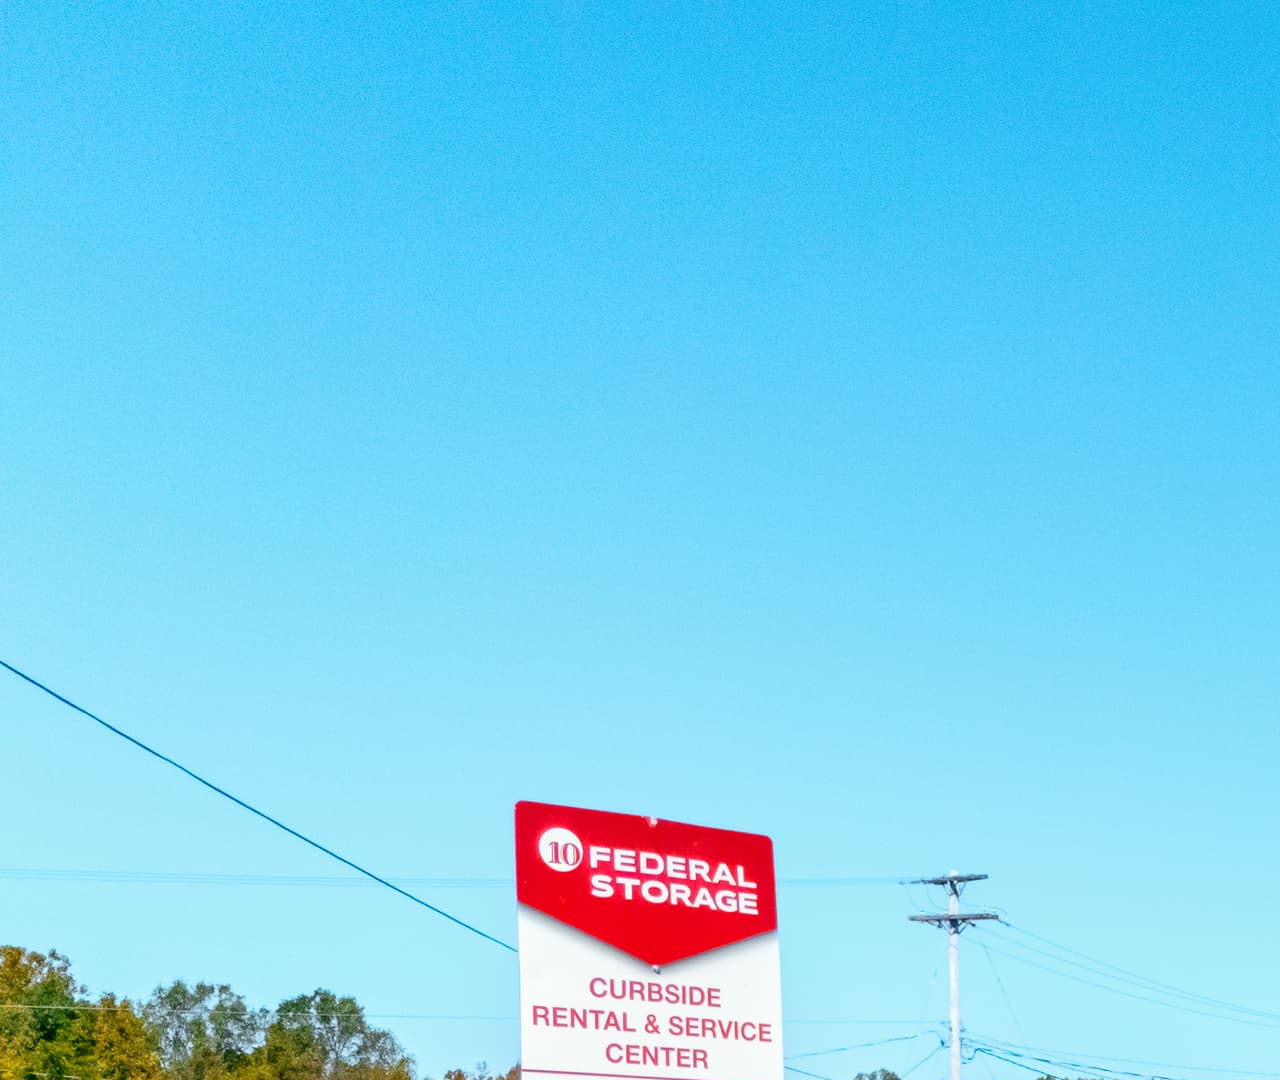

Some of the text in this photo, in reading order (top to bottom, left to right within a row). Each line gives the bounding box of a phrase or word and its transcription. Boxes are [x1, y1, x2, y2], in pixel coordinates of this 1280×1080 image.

[548, 840, 758, 889] 10 FEDERAL
[591, 875, 759, 916] STORAGE
[589, 977, 722, 1008] CURBSIDE
[532, 1005, 773, 1042] RENTAL & SERVICE
[605, 1043, 709, 1069] CENTER
